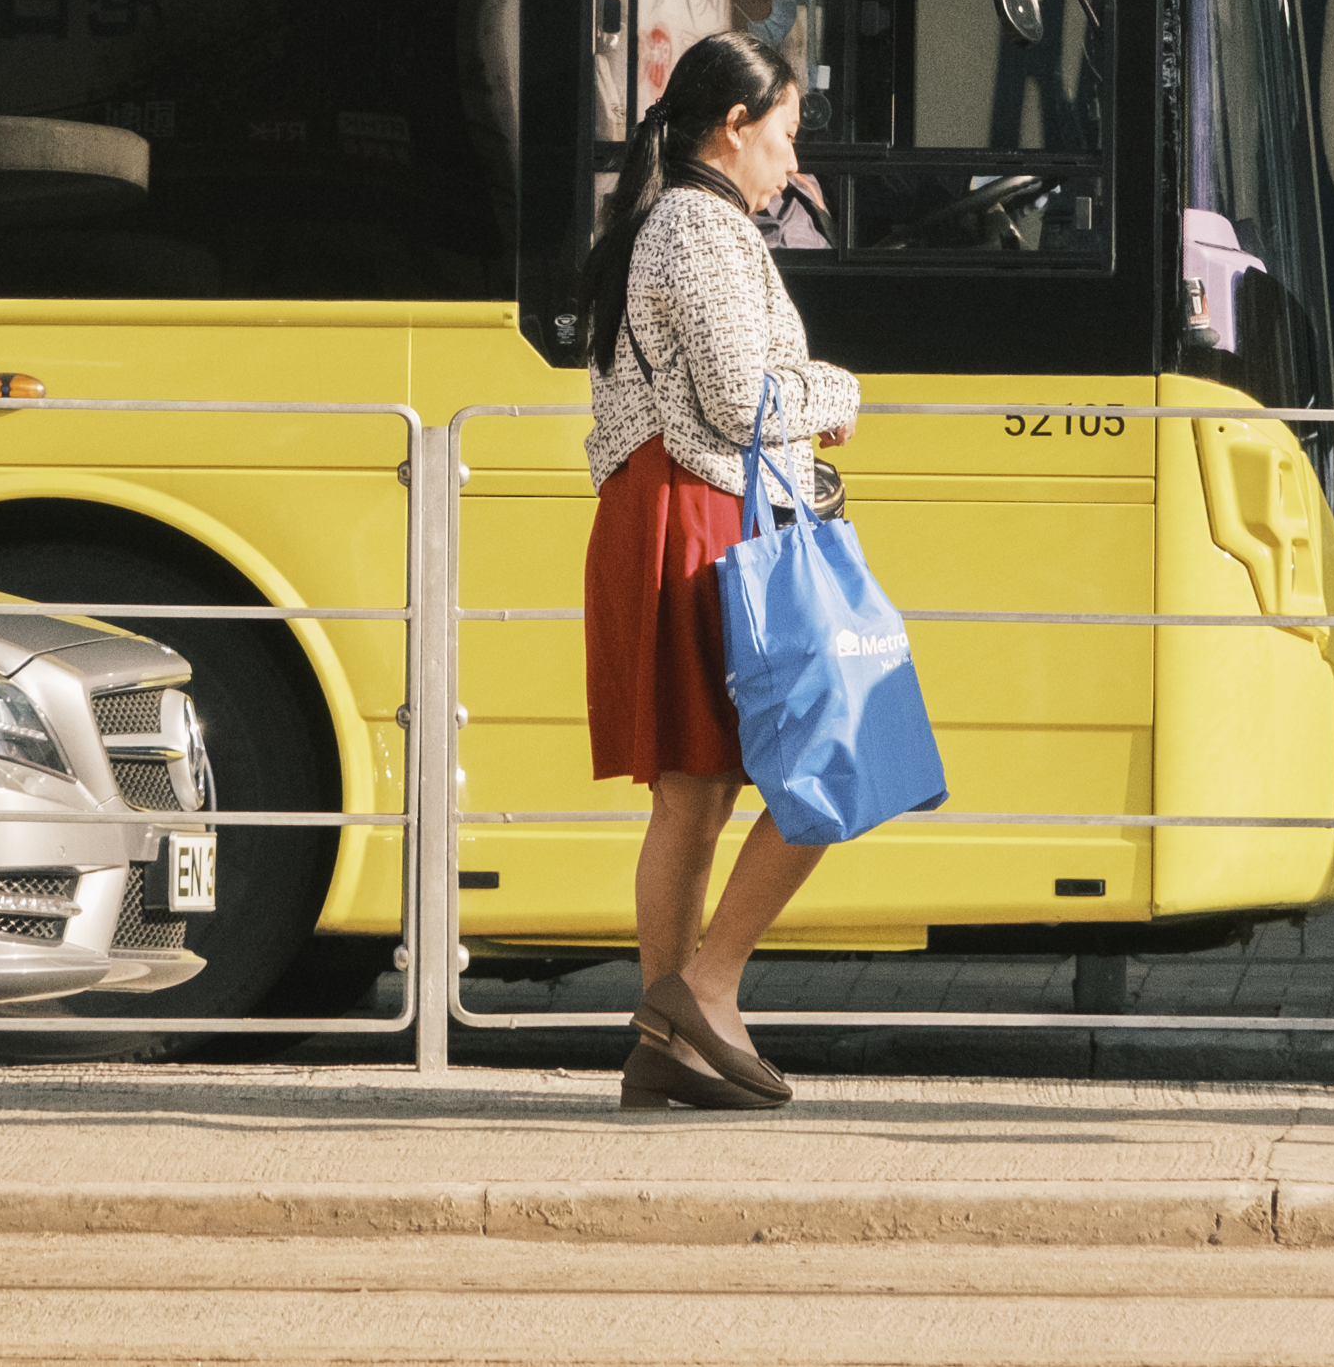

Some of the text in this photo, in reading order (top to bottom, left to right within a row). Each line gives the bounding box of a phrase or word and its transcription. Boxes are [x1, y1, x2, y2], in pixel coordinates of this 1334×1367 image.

[1004, 402, 1126, 437] 52105
[861, 632, 910, 656] Metro
[178, 846, 202, 897] EN
